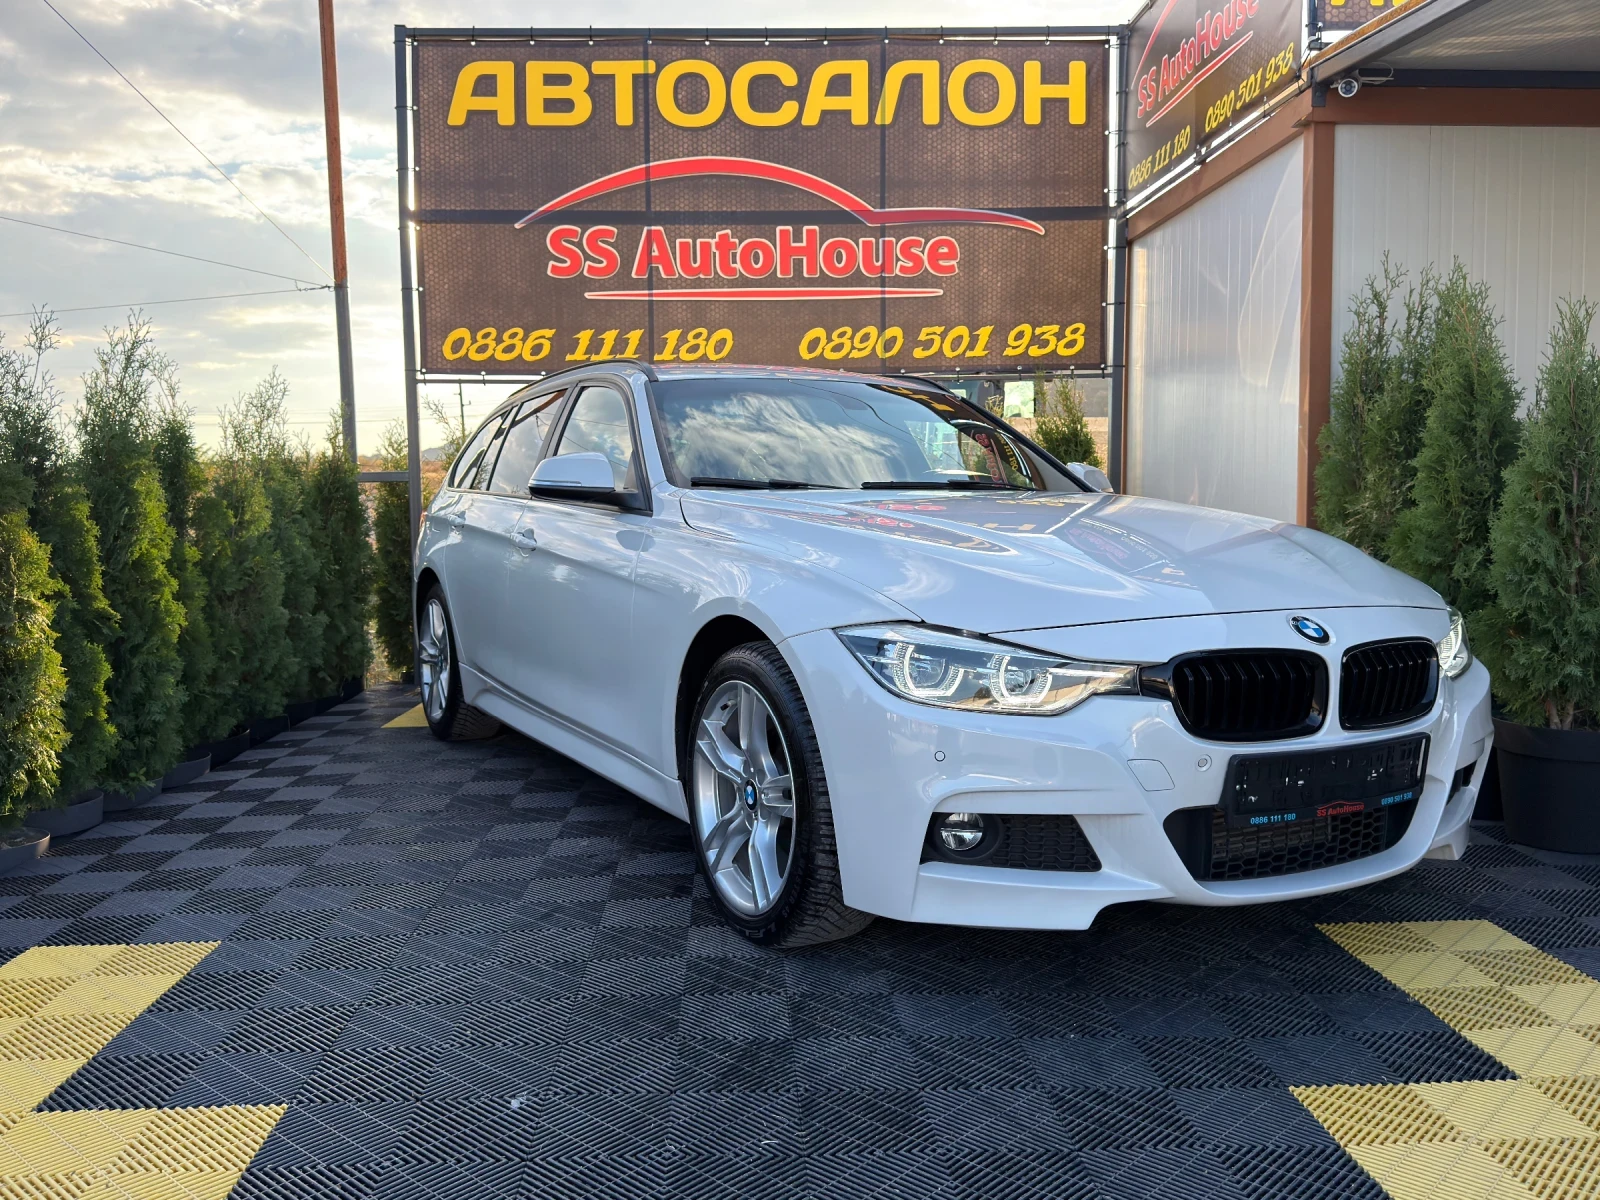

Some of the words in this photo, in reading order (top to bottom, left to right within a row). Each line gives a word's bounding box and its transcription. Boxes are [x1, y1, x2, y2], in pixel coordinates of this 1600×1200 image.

[447, 59, 1087, 127] АВТОСАЛОН
[1137, 66, 1156, 118] SS
[1205, 89, 1234, 133] 0890
[1236, 67, 1263, 111] 501
[1265, 42, 1294, 89] 938
[1128, 157, 1152, 190] 0886
[1153, 141, 1171, 174] 111
[1171, 125, 1191, 160] 180
[546, 226, 620, 279] SS
[632, 225, 960, 279] AutoHouse
[442, 327, 556, 361] 0886
[565, 328, 644, 361] 111
[654, 327, 734, 361] 180
[798, 325, 904, 360] 0890
[912, 325, 994, 358] 501
[1002, 322, 1086, 357] 938
[1250, 816, 1268, 824] 0886
[1270, 814, 1281, 823] 111
[1284, 813, 1296, 821] 180
[1316, 808, 1326, 817] SS
[1328, 804, 1364, 815] AutoHouse
